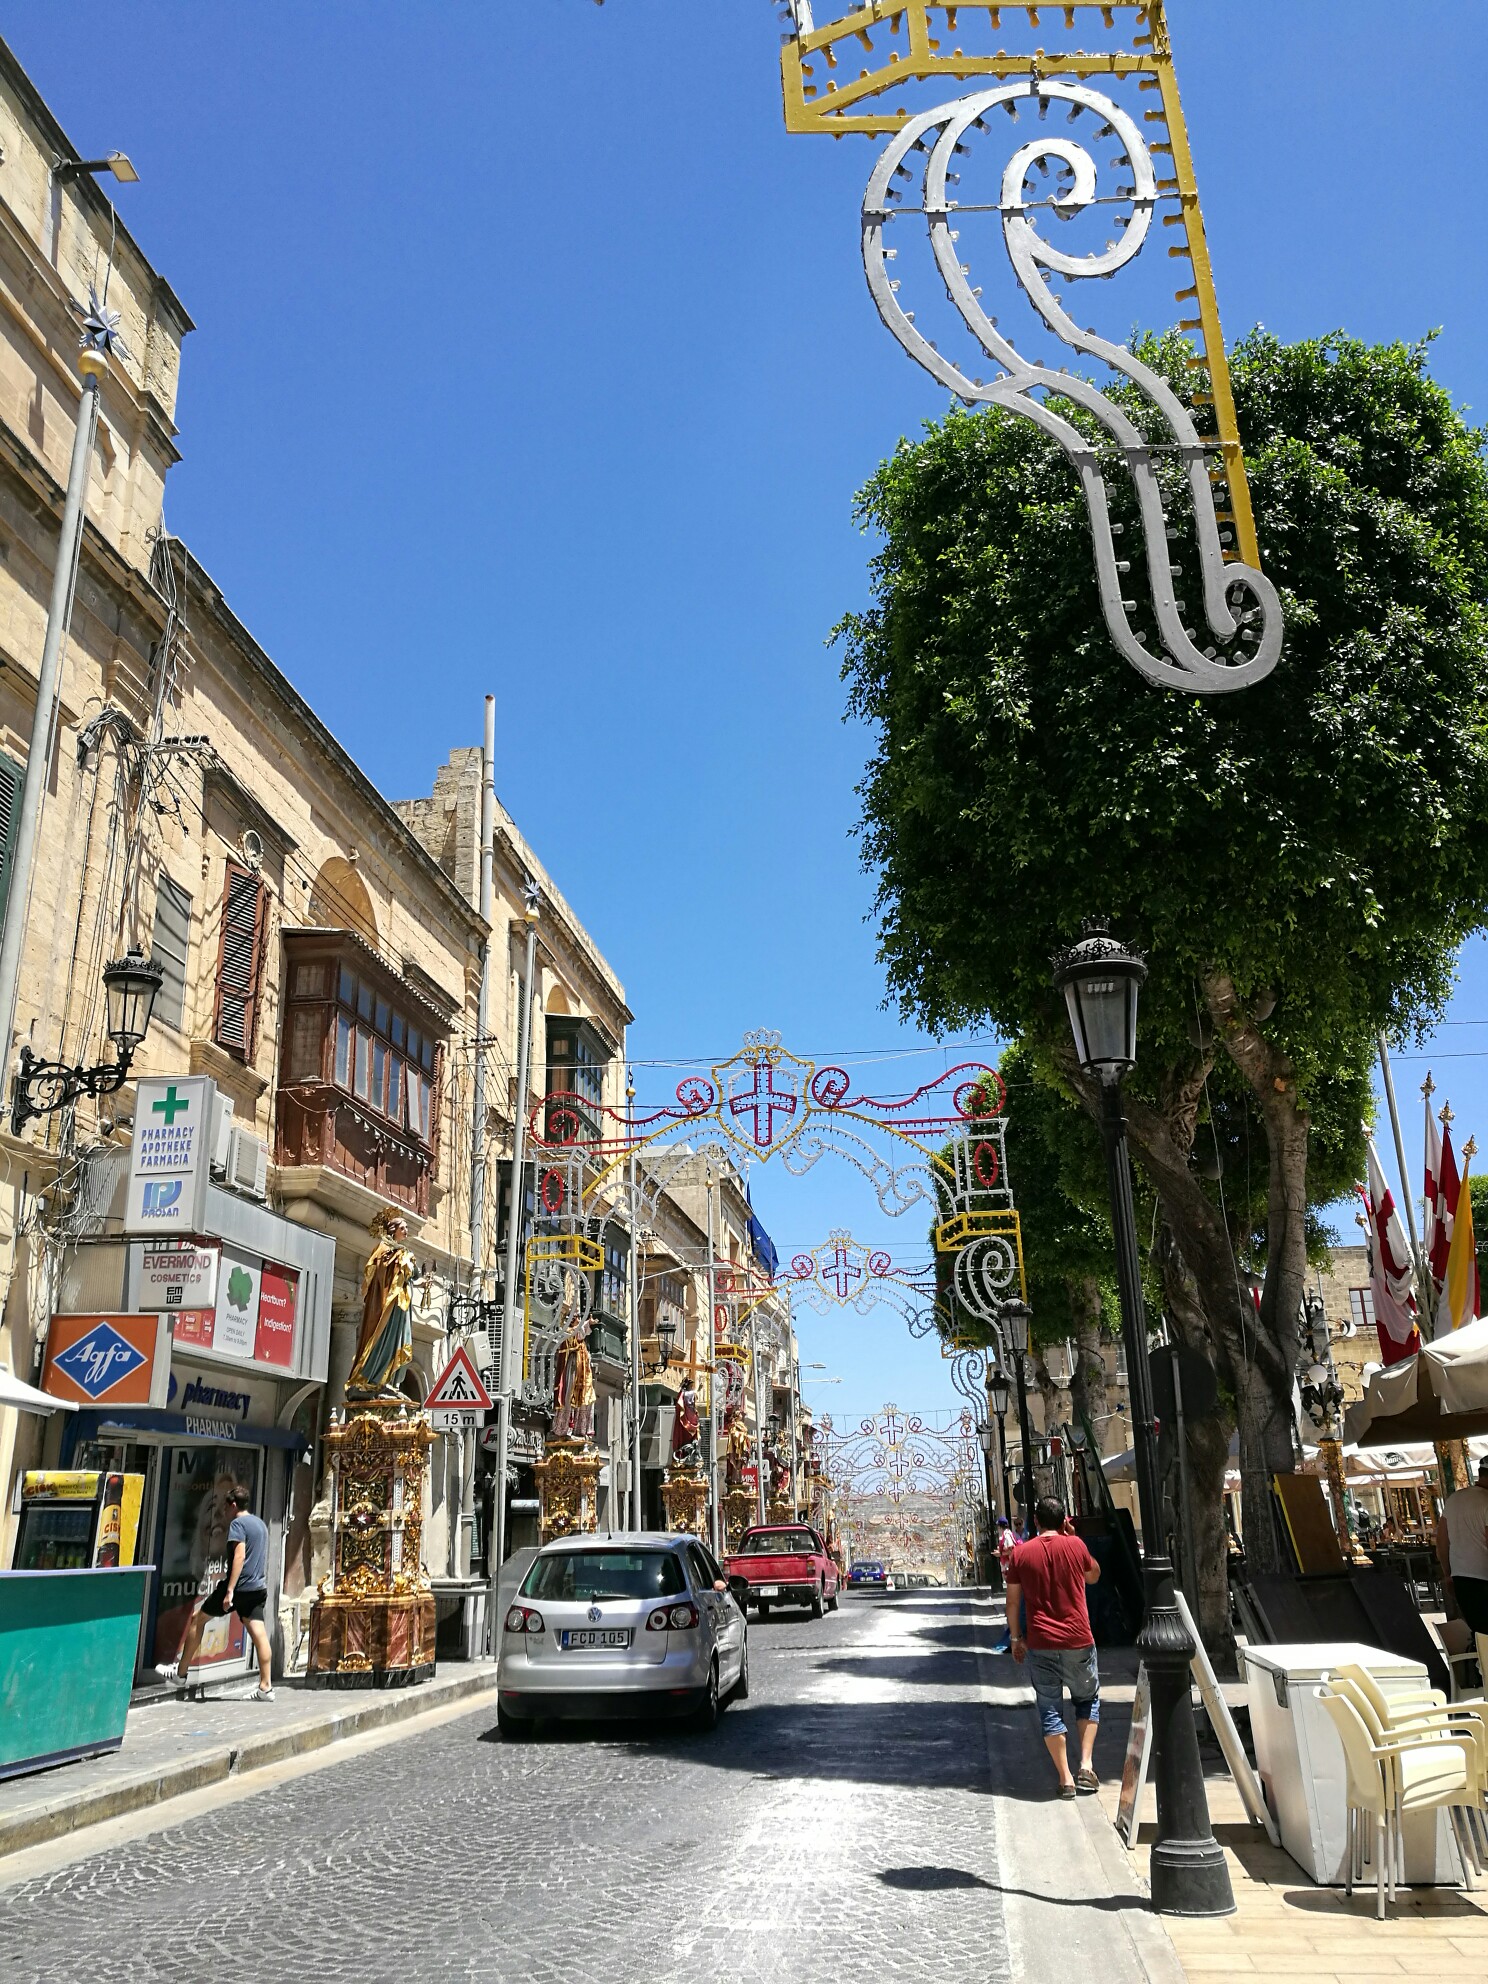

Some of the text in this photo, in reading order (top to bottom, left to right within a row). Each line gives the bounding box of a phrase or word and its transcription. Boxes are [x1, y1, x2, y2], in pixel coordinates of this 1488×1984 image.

[141, 1126, 194, 1141] PHARMACY
[141, 1140, 192, 1155] APOTHEKE
[140, 1154, 189, 1168] FARMACIA
[143, 1253, 211, 1270] EVERMOND
[150, 1273, 202, 1284] COSMETICS
[260, 1292, 287, 1308] Heartburn?
[226, 1313, 248, 1326] PHARMACY
[264, 1317, 292, 1333] Indigestion?
[65, 1341, 132, 1384] Agfa
[181, 1376, 251, 1420] pharmacy
[443, 1413, 475, 1425] 15 m
[186, 1416, 237, 1439] PHARMACY
[25, 1483, 56, 1495] CISK
[104, 1523, 120, 1534] CIS
[163, 1576, 213, 1597] much
[571, 1632, 624, 1645] FCD 105
